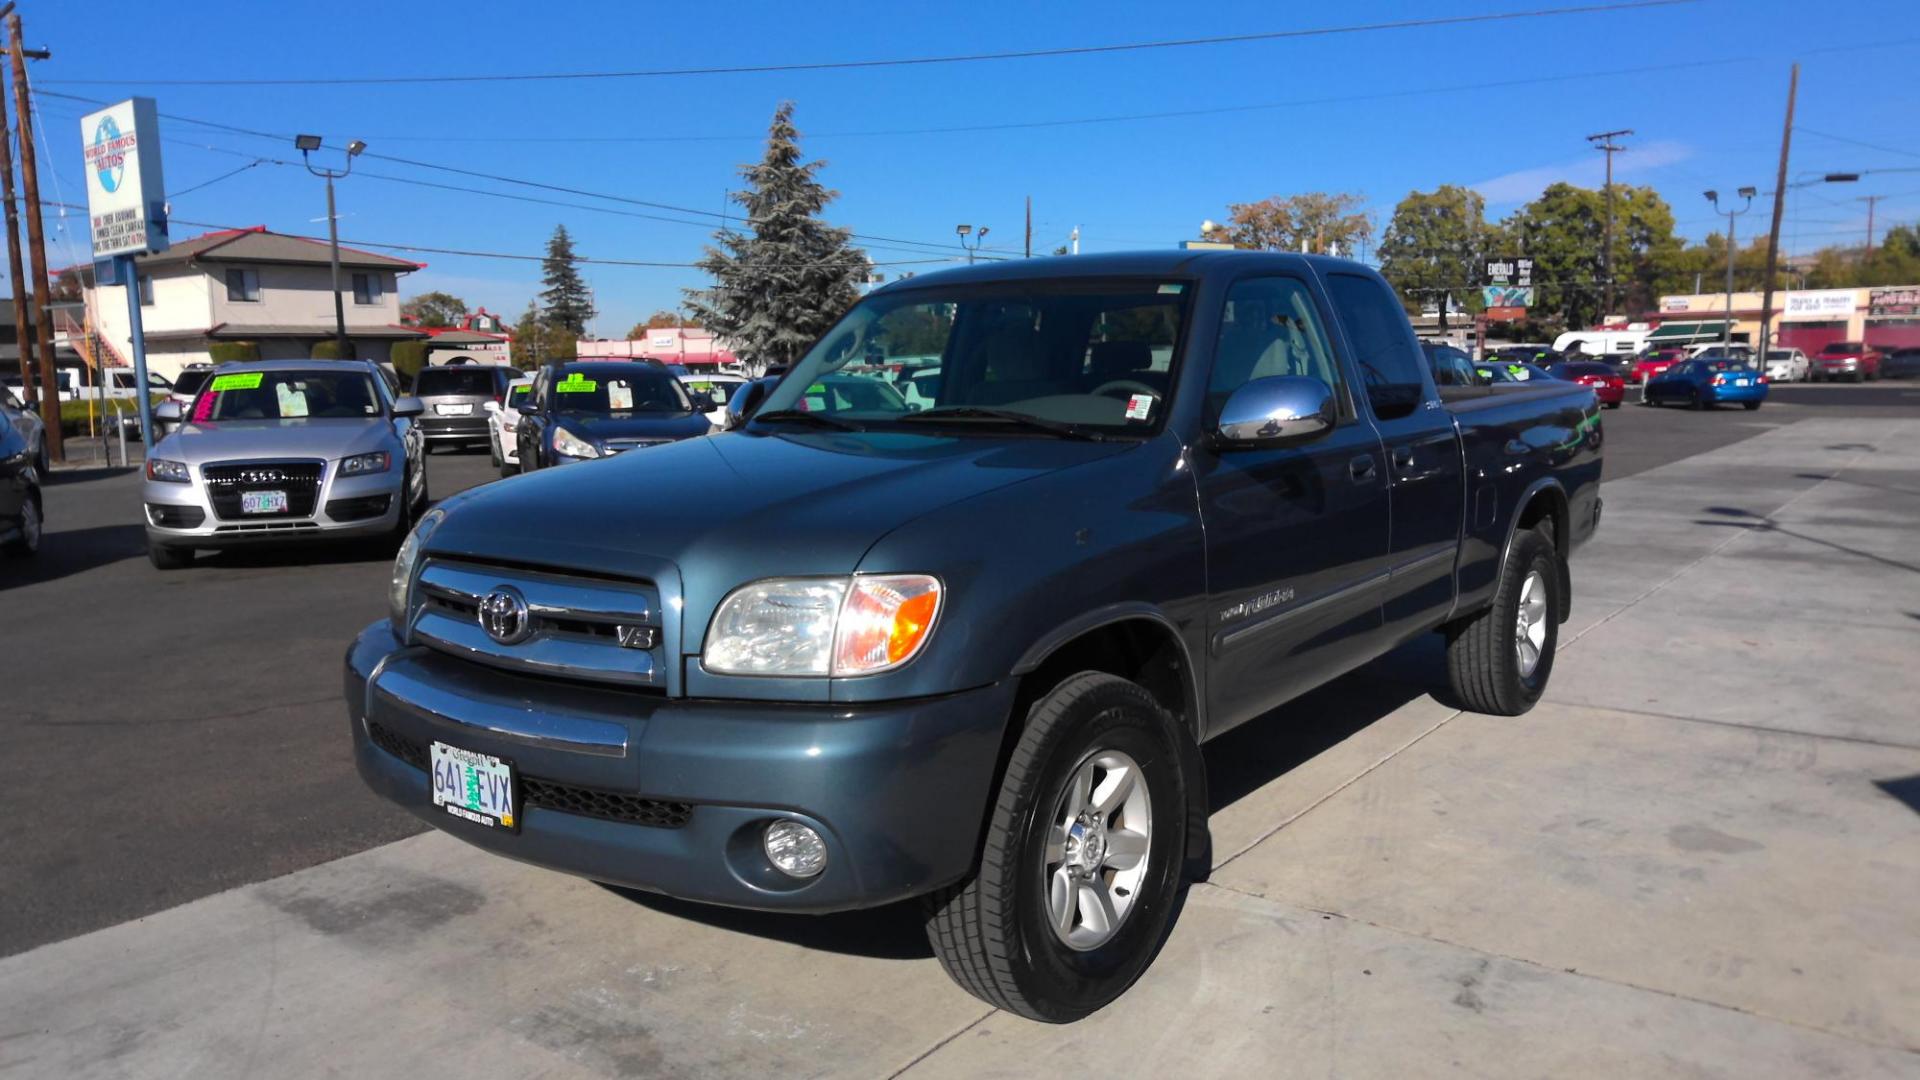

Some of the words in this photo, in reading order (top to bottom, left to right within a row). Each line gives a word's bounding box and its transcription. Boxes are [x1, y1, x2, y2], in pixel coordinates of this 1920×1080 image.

[86, 144, 106, 158] WORLD
[107, 134, 136, 151] FAMOUS
[1487, 263, 1513, 276] EMERALD
[243, 496, 261, 509] 607
[435, 759, 463, 800] 641
[475, 768, 512, 815] EVX
